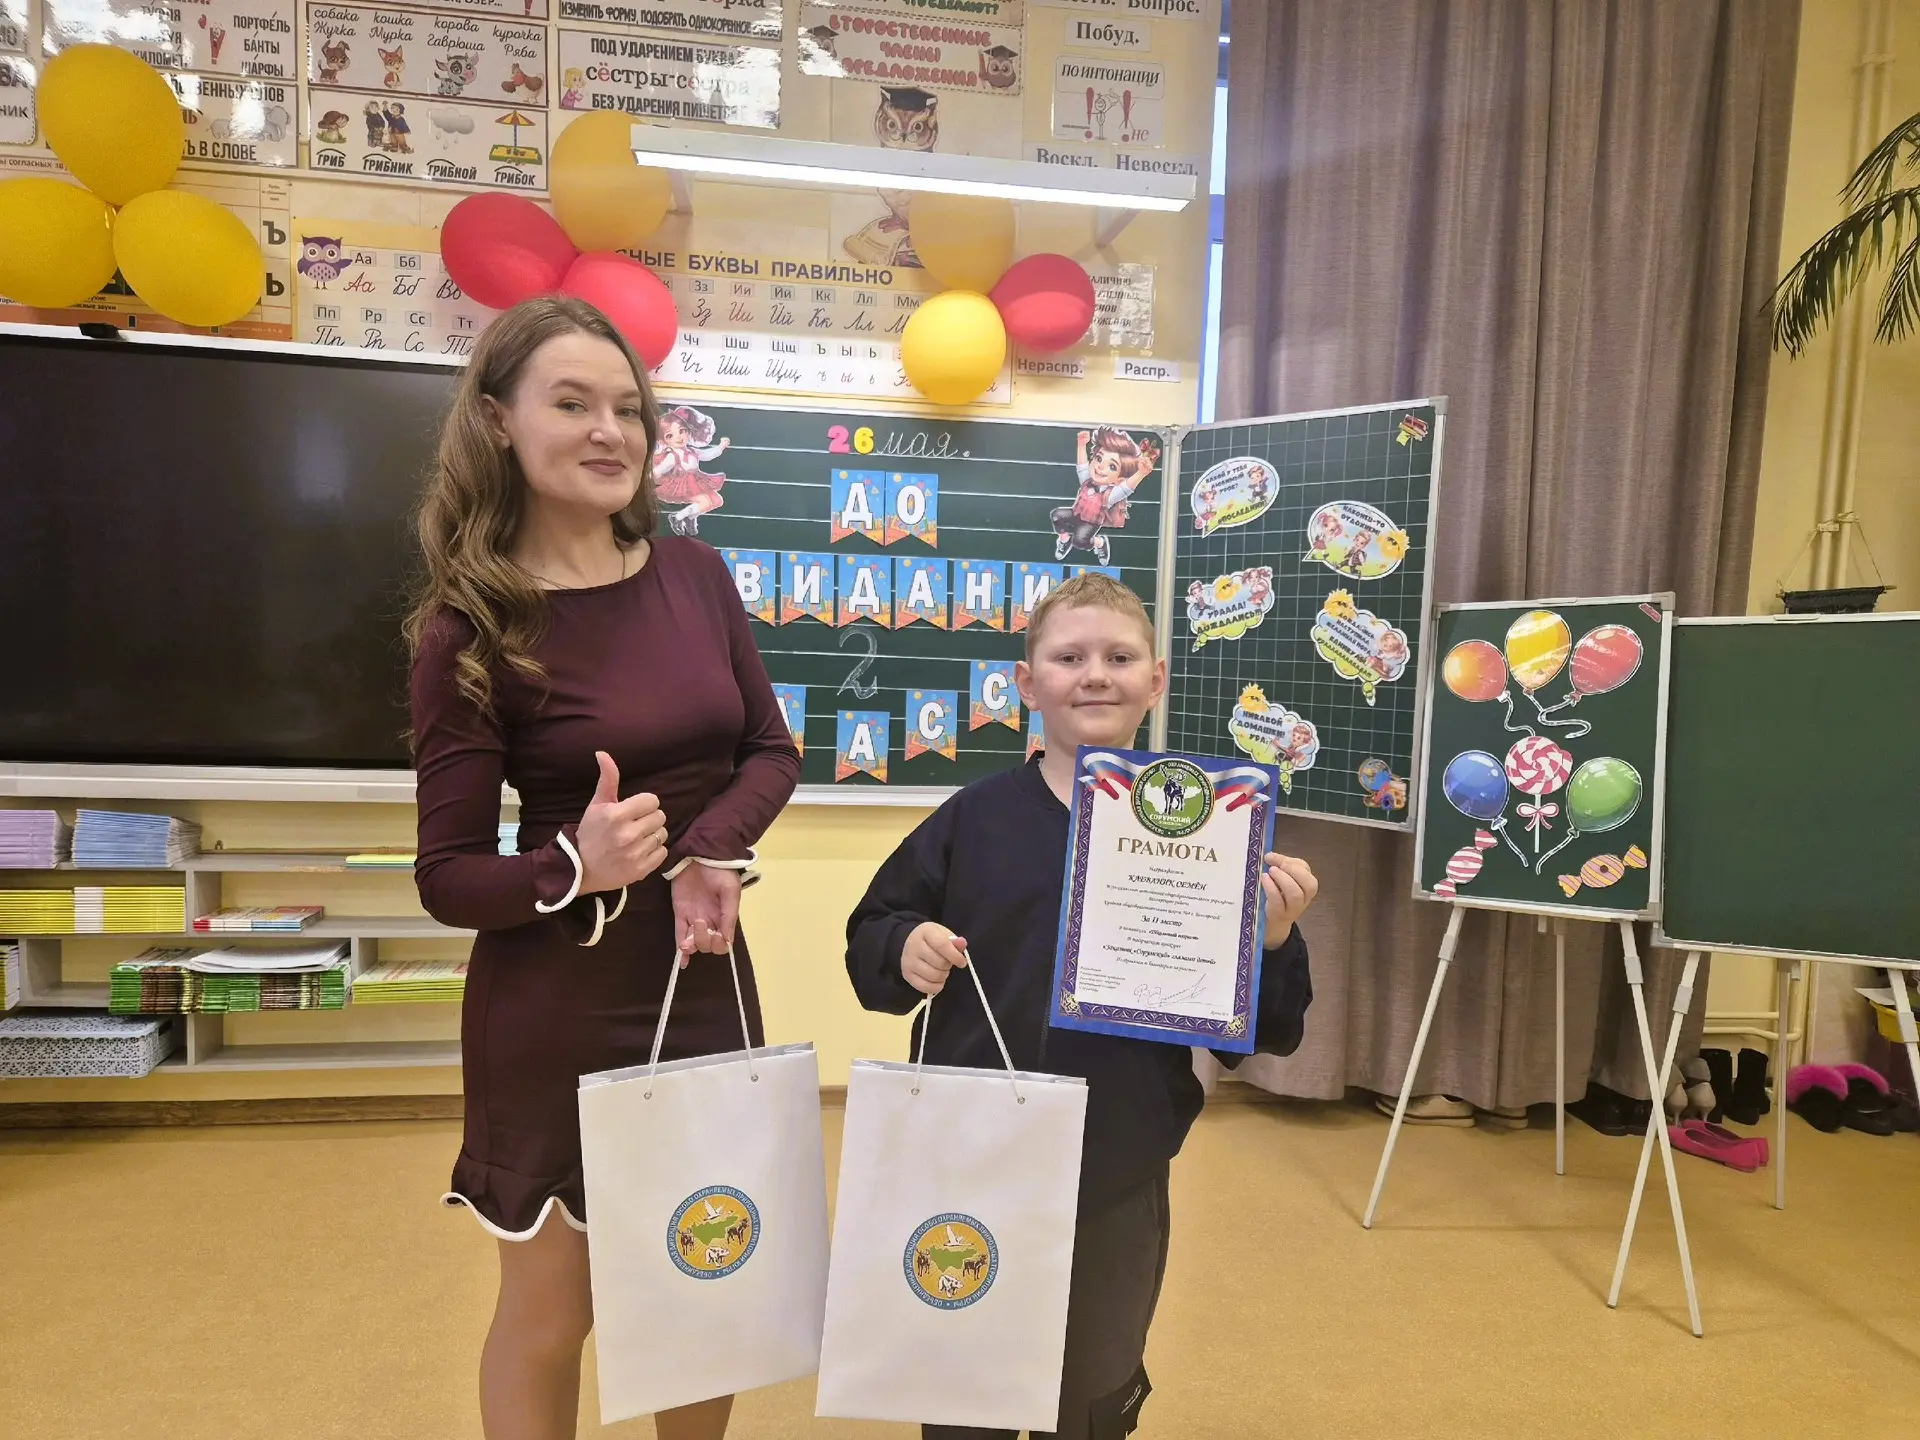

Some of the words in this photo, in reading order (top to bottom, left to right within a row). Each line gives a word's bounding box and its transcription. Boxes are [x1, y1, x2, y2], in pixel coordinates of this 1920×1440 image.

[314, 8, 359, 23] собака
[373, 11, 414, 27] кошка
[433, 18, 479, 34] корова
[492, 24, 542, 43] курочка
[640, 10, 687, 28] ПОДОБРАТЬ
[828, 14, 992, 47] ВТОРОСТЕПЕННЫЕ
[314, 21, 356, 38] Жучка
[369, 27, 413, 44] Мурка
[427, 34, 485, 52] Гаврюша
[504, 44, 538, 60] Ряба
[1076, 21, 1140, 46] Побуд.
[591, 38, 617, 56] ПОД
[620, 40, 693, 62] УДАРЕНИЕМ
[879, 41, 942, 62] ЧЛЕНЫ
[841, 57, 978, 87] ПРЕДЛОЖЕНИЯ
[592, 93, 614, 109] БЕЗ
[617, 96, 680, 116] УДАРЕНИЯ
[9, 159, 53, 168] согласных
[200, 140, 208, 156] В
[212, 143, 257, 161] СЛОВЕ
[1037, 148, 1098, 167] Воскл.
[1116, 154, 1199, 175] Невоскл.
[317, 153, 345, 168] ГРИБ
[363, 158, 413, 175] ГРИБНИК
[428, 163, 477, 181] ГРИБНОЙ
[495, 171, 535, 186] ГРИБОК
[262, 220, 287, 245] Ъ
[355, 252, 372, 265] Аа
[400, 256, 416, 268] Бб
[694, 280, 708, 292] Зз
[734, 284, 751, 296] Ии
[775, 286, 793, 299] Йй
[816, 290, 831, 302] Кк
[857, 293, 873, 305] Лл
[897, 297, 920, 308] Мм
[689, 254, 759, 275] БУКВЫ
[771, 261, 893, 285] ПРАВИЛЬНО
[266, 273, 285, 296] Ь
[343, 272, 376, 293] Аа
[393, 275, 426, 296] Бб
[692, 298, 712, 327] Зз
[729, 301, 754, 322] Ии
[770, 303, 795, 326] Йй
[808, 308, 833, 329] Кк
[844, 311, 875, 331] Лл
[317, 307, 336, 319] Пп
[366, 310, 382, 323] Рр
[410, 313, 426, 325] Сс
[457, 317, 473, 329] Тт
[684, 334, 699, 346] Чч
[726, 338, 749, 349] Шш
[772, 340, 796, 354] Щщ
[311, 325, 345, 347] Пп
[405, 331, 424, 352] Сс
[681, 352, 703, 373] Чч
[717, 355, 751, 375] Шш
[766, 359, 801, 383] Щщ
[1018, 358, 1083, 376] Нераспр.
[1125, 363, 1170, 379] Распр.
[827, 425, 875, 455] 26
[877, 428, 973, 459] мая.
[842, 482, 926, 530] ДО
[1117, 837, 1218, 863] ГРАМОТА
[1141, 915, 1151, 924] За
[1160, 919, 1183, 927] место
